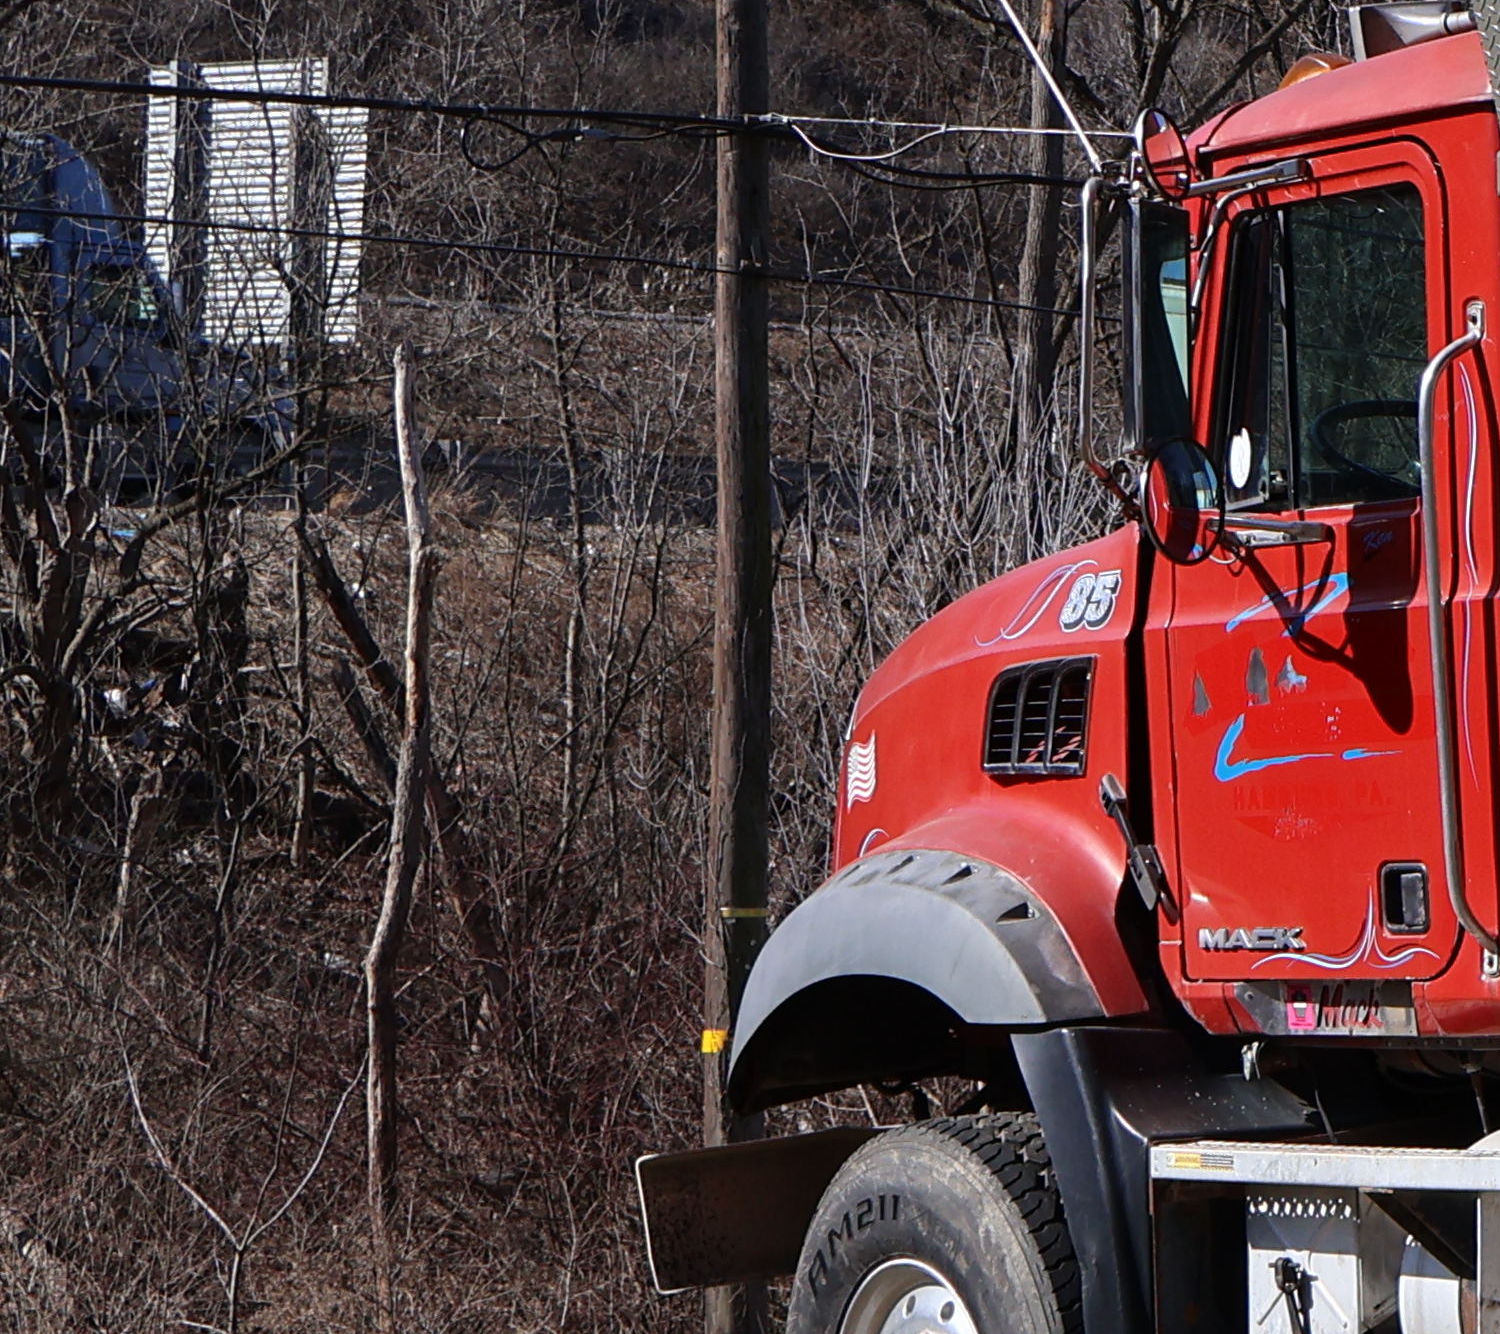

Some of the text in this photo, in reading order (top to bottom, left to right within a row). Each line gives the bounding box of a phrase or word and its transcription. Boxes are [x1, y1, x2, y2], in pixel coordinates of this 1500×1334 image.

[1059, 570, 1121, 632] 85
[1198, 928, 1308, 952] MACK
[1317, 984, 1384, 1028] Mack
